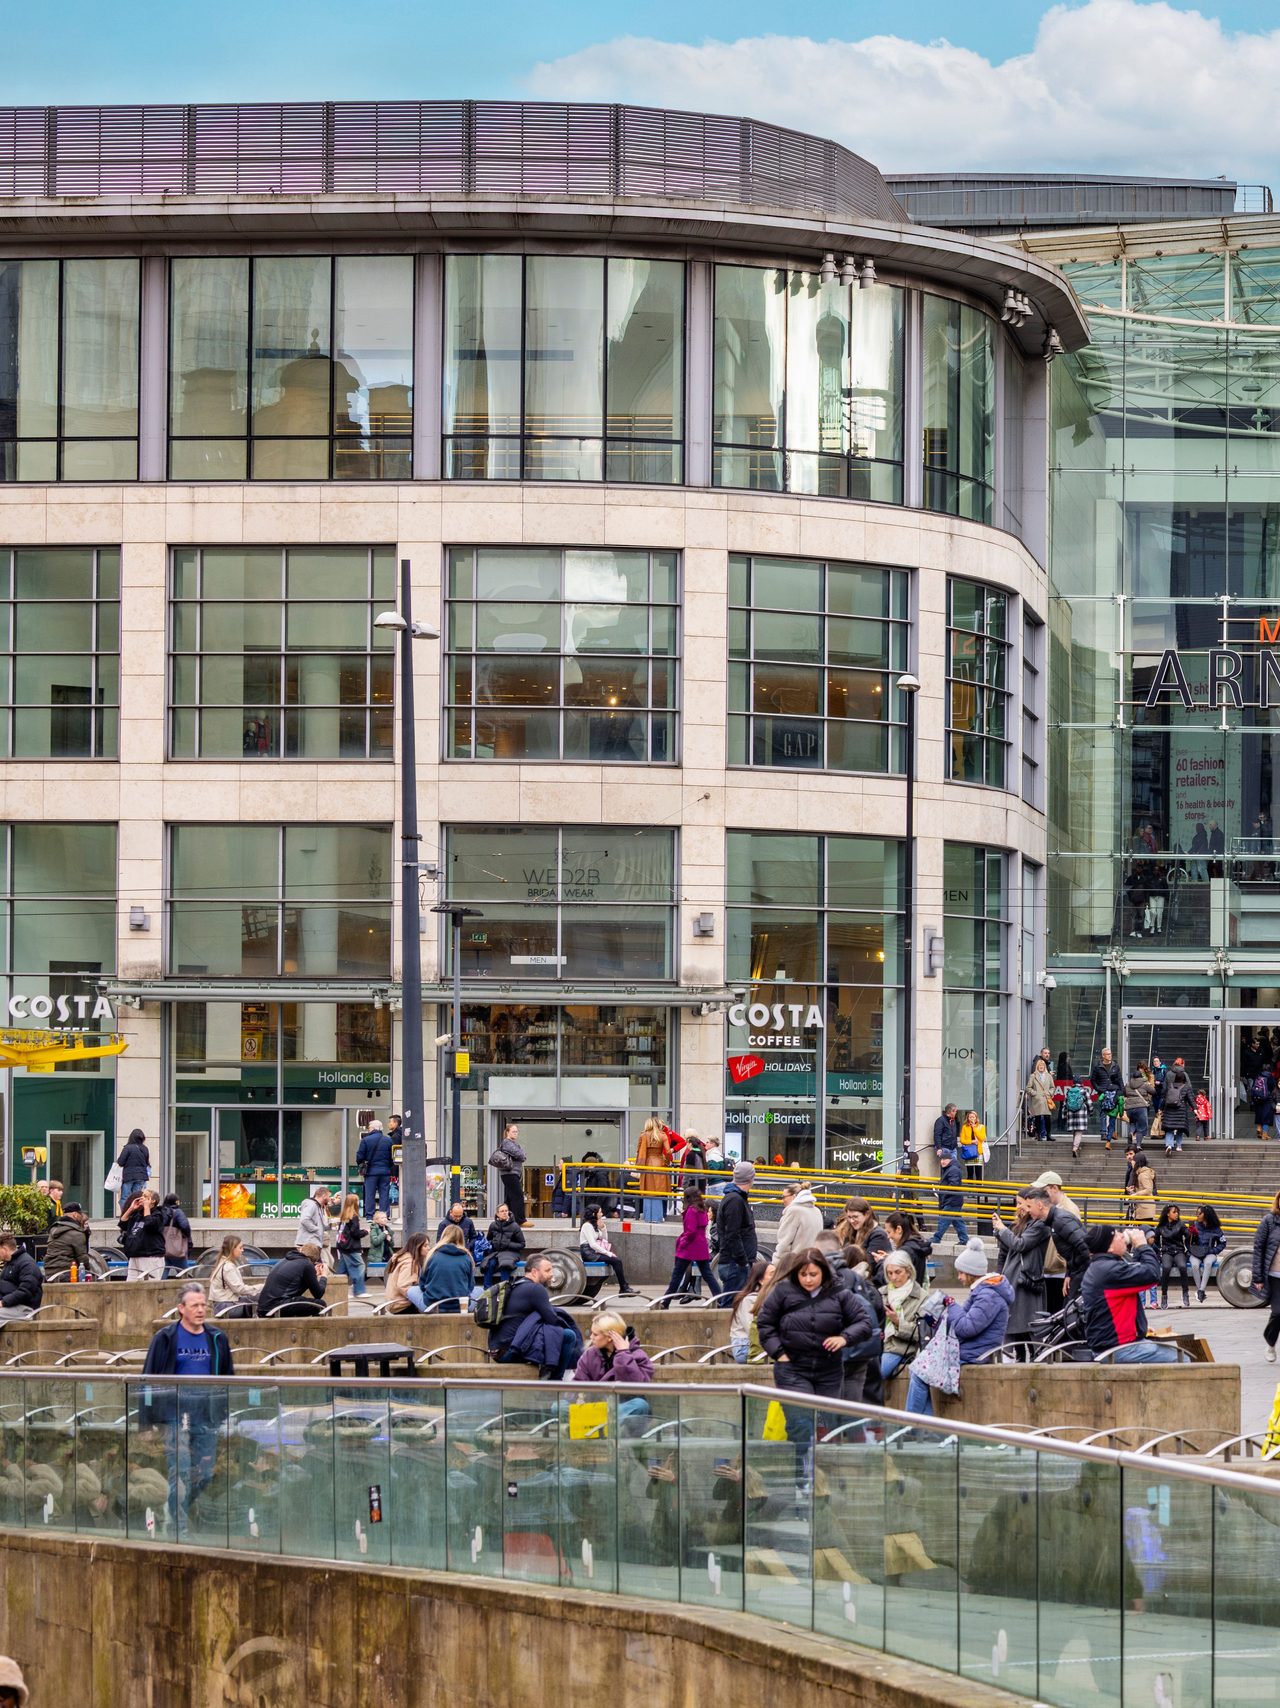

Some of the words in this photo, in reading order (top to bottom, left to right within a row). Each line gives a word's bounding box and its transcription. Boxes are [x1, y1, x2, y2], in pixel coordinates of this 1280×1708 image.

[784, 733, 815, 757] GAP
[1176, 758, 1188, 771] 60
[1190, 757, 1225, 771] fashion
[1176, 774, 1219, 787] retailers,
[1176, 801, 1184, 810] 16
[1185, 800, 1206, 810] health
[1207, 799, 1212, 809] &
[1213, 798, 1236, 809] beauty
[523, 868, 601, 886] WED2B
[527, 888, 557, 898] BRIDA
[564, 888, 594, 898] WEAR
[8, 994, 115, 1022] COSTA
[728, 1002, 824, 1031] COSTA
[747, 1035, 801, 1047] COFFEE
[736, 1056, 758, 1079] Virgin
[764, 1062, 812, 1073] HOLIDAYS
[63, 1113, 88, 1125] LIFT
